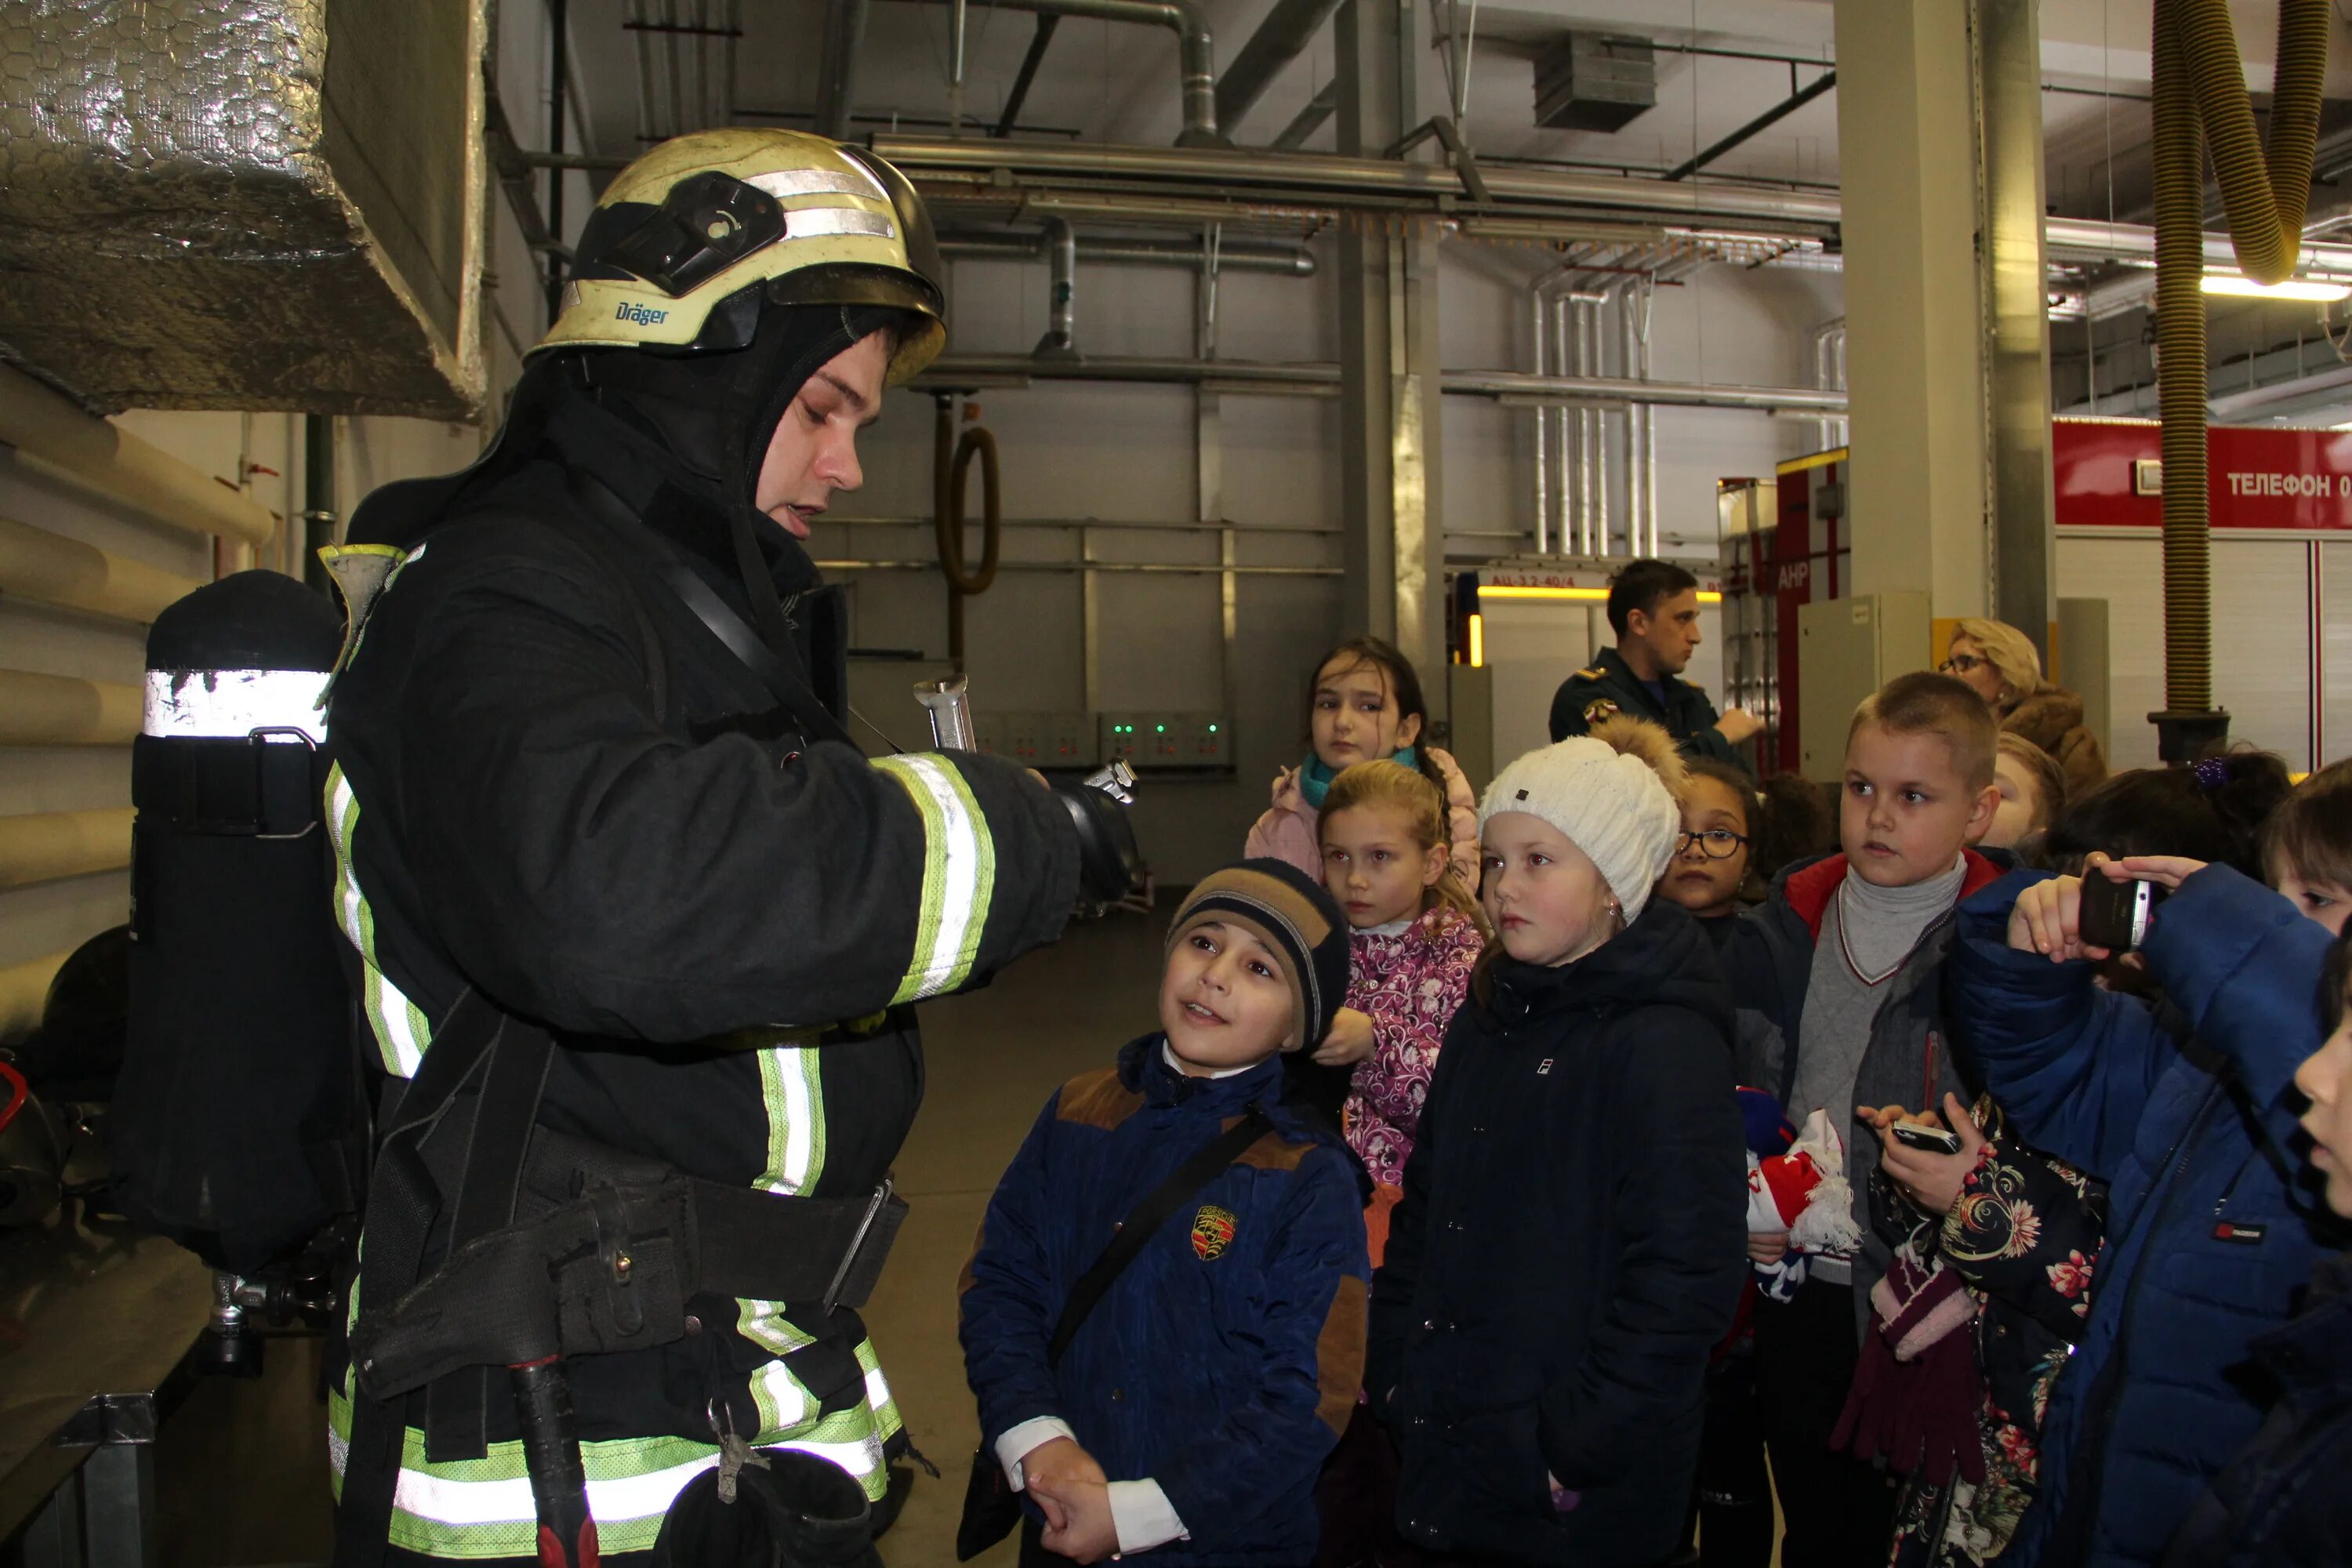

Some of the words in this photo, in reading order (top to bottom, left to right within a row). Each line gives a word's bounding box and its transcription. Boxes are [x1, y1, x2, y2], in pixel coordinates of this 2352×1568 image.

[615, 302, 669, 325] Dräger
[2227, 473, 2331, 497] ТЕЛЕФОН
[1778, 562, 1809, 590] АНР
